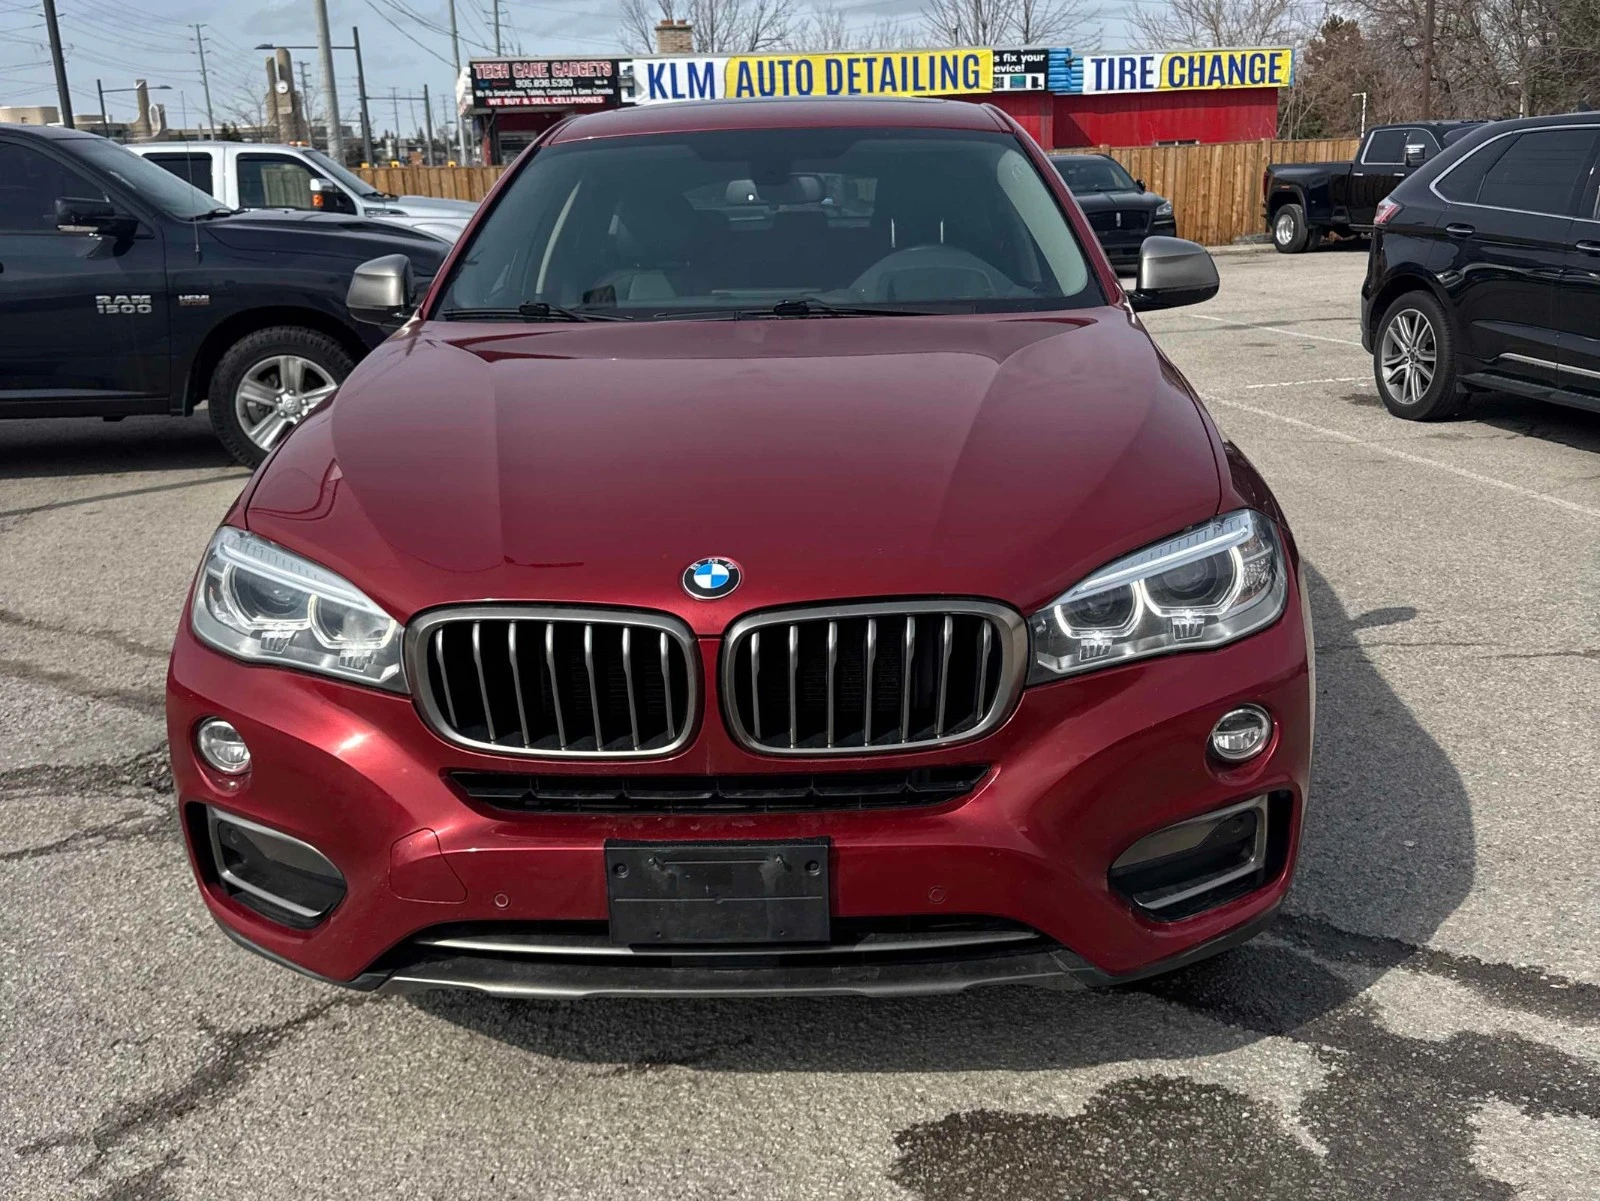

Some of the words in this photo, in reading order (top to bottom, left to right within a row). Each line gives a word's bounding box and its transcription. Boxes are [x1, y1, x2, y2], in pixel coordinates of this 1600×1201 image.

[1003, 53, 1017, 62] fix
[1020, 54, 1045, 65] your
[473, 63, 510, 79] TECH
[512, 62, 549, 78] CARE
[551, 61, 613, 77] GADGETS
[1091, 56, 1155, 91] TIRE
[1168, 53, 1283, 88] CHANGE
[647, 62, 716, 100] KLM
[736, 59, 814, 97] AUTO
[825, 54, 980, 96] DETAILING
[488, 98, 502, 106] WE
[504, 97, 520, 105] BUY
[522, 97, 530, 105] &
[531, 96, 551, 104] SELL
[552, 96, 604, 104] CELLPHONES
[95, 295, 151, 304] RAM
[96, 304, 152, 314] 1500
[689, 558, 737, 571] BMW
